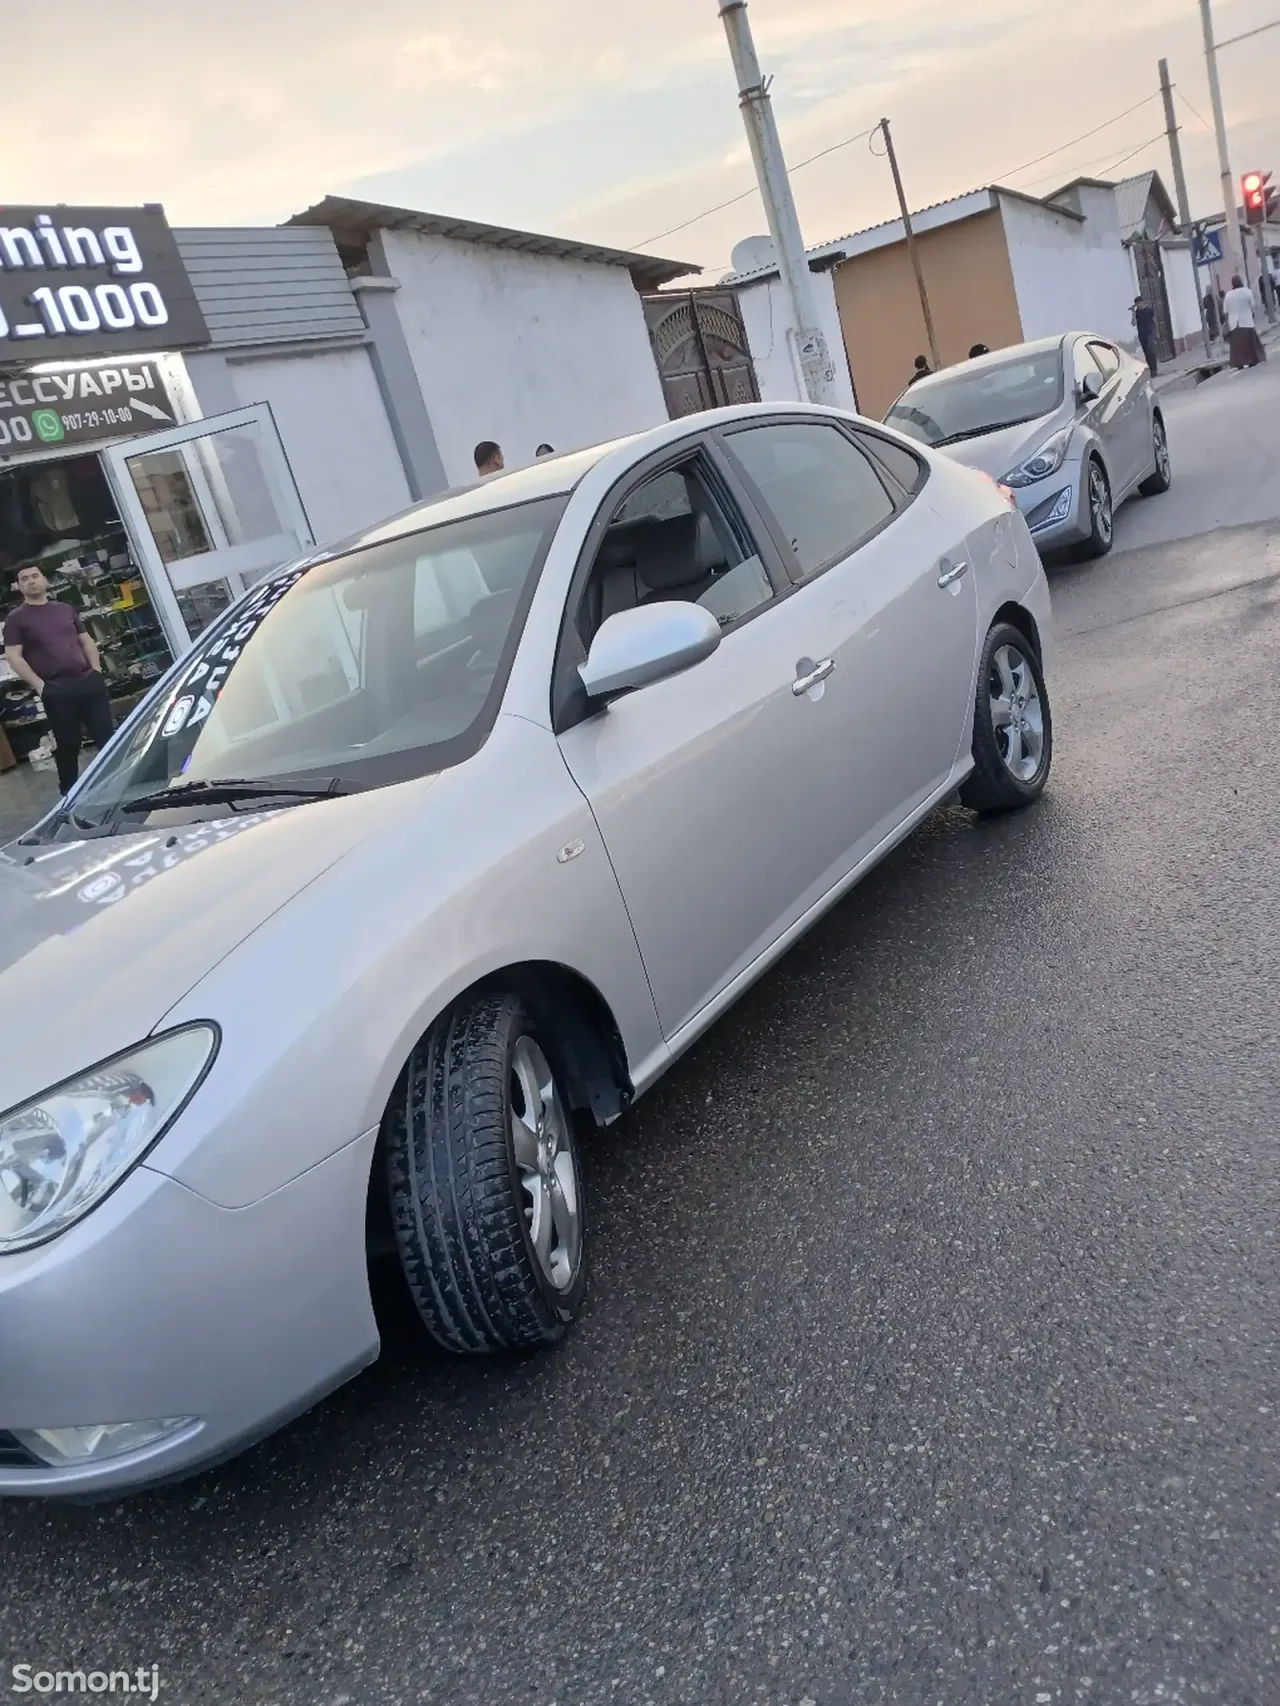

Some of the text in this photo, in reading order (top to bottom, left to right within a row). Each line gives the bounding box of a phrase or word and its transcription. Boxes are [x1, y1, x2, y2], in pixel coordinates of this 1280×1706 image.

[0, 214, 143, 275] ning
[0, 282, 169, 338] _1000
[62, 407, 133, 431] 907-29-10-00
